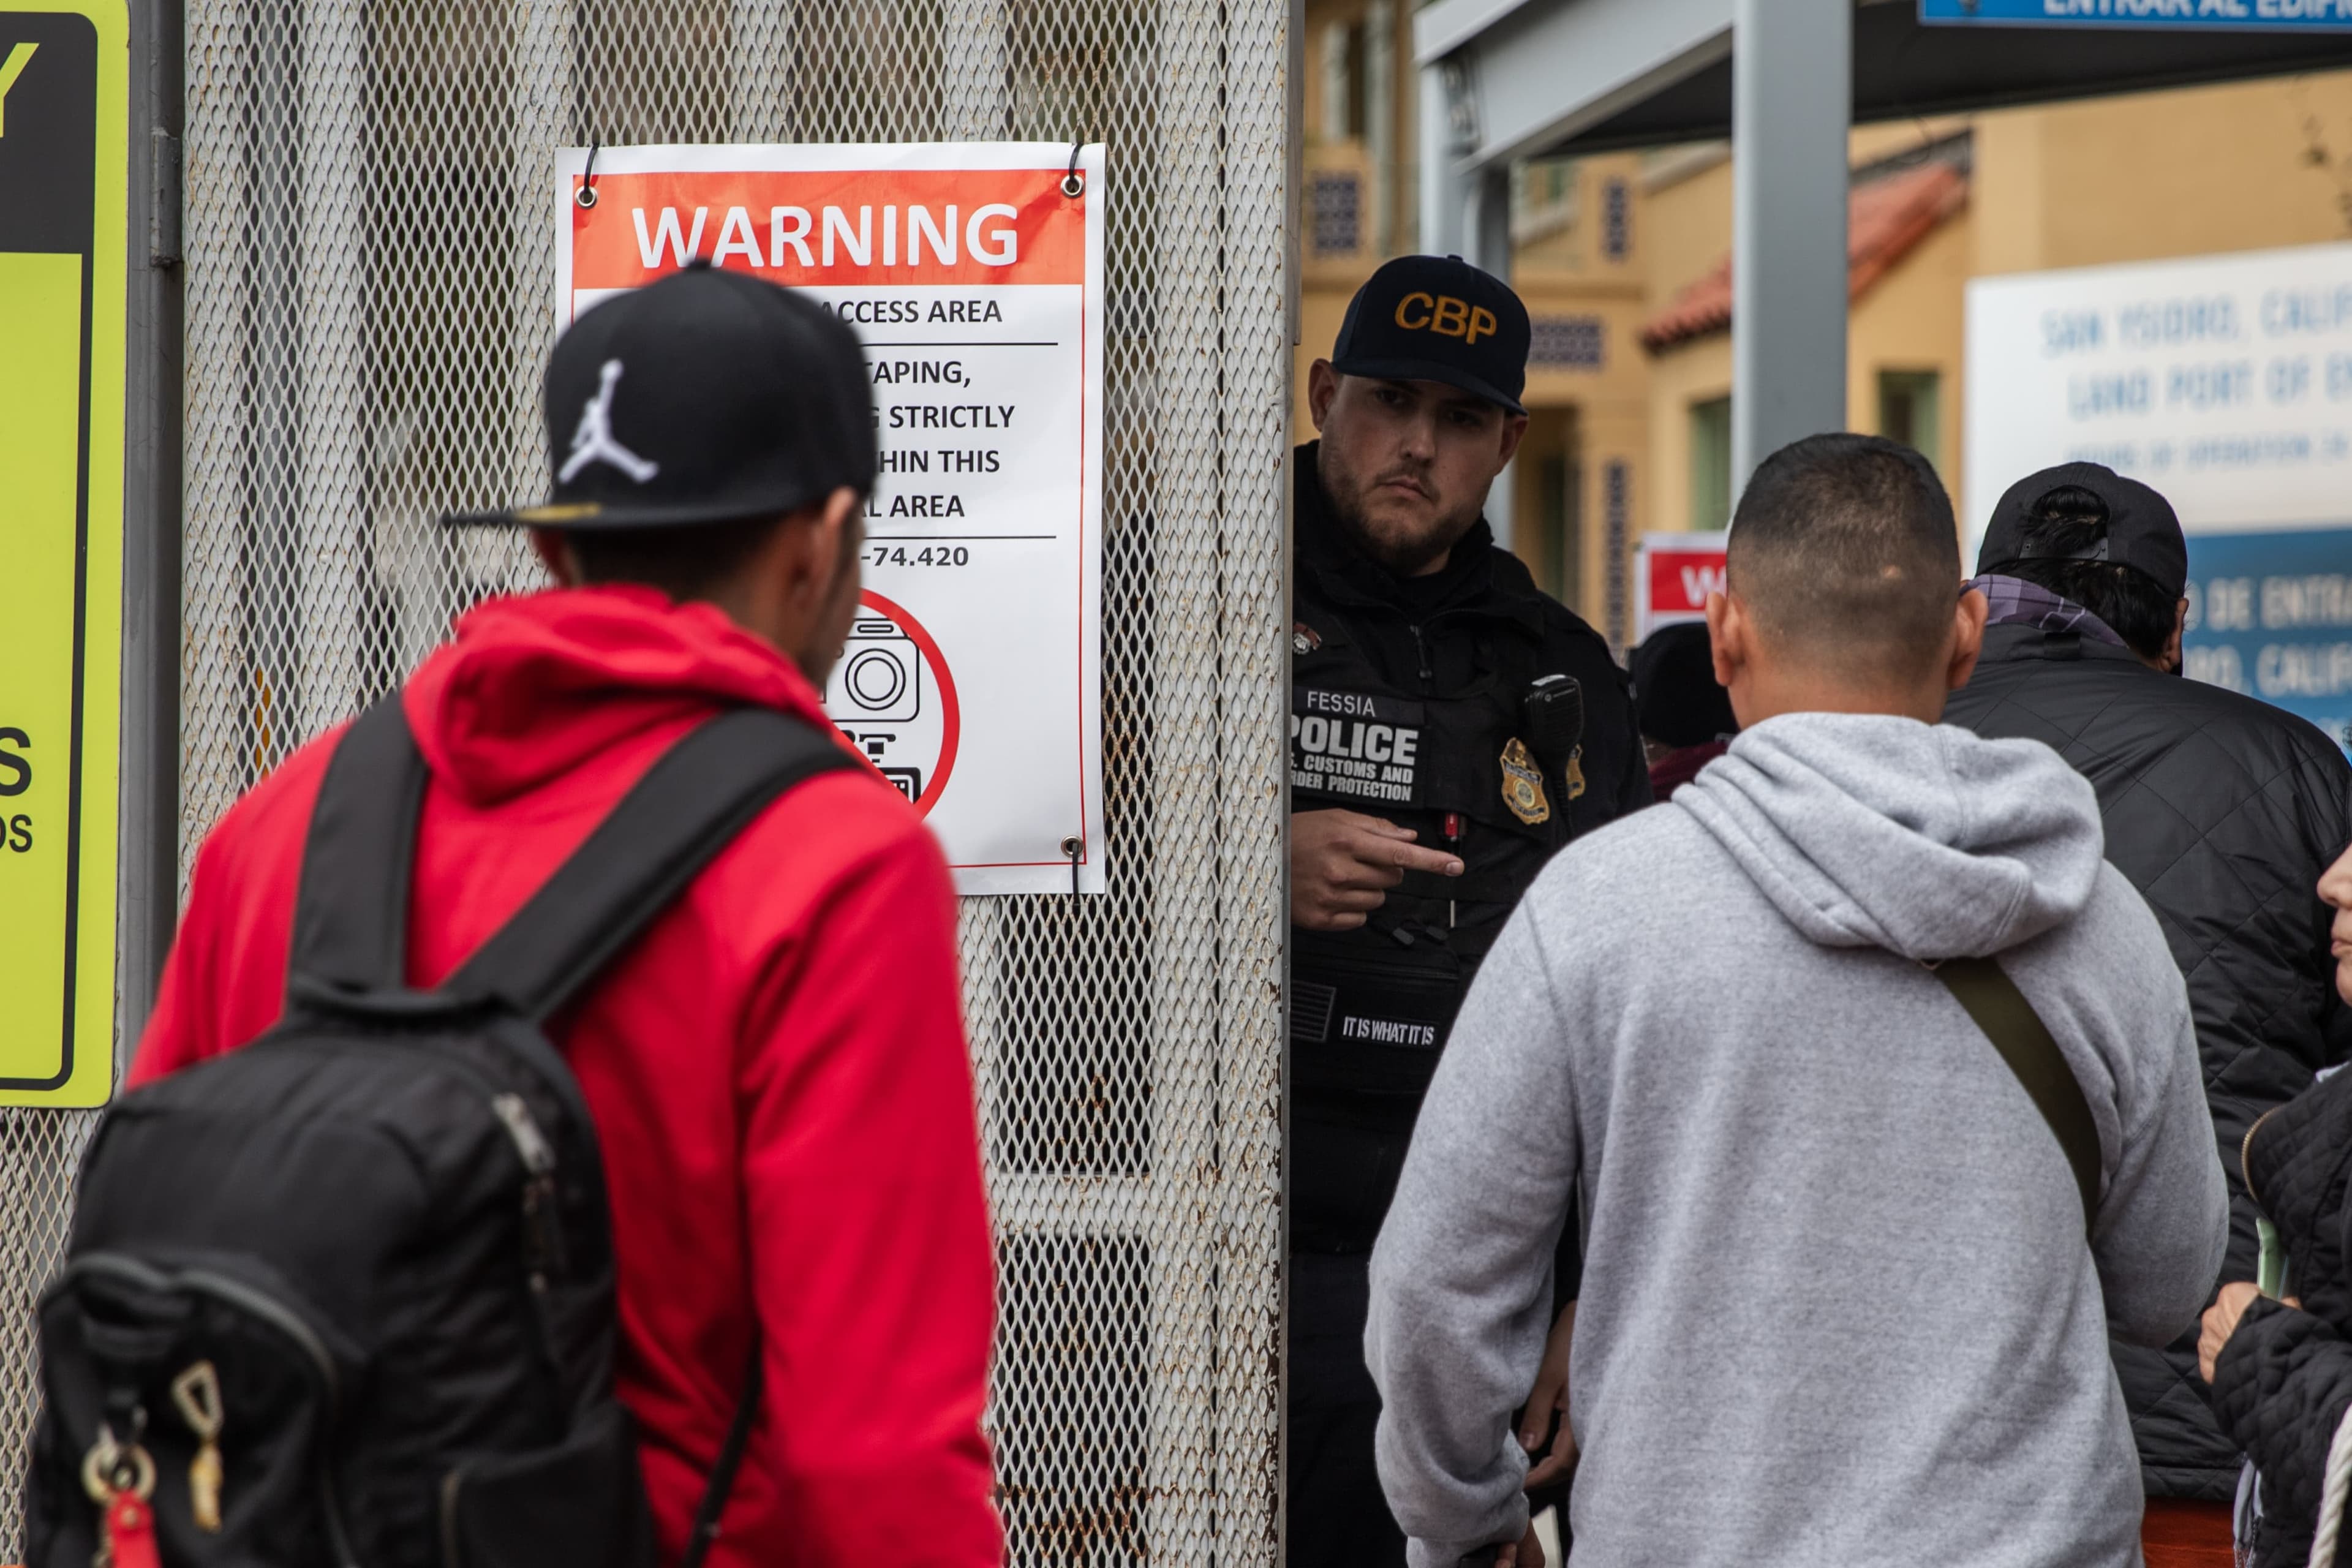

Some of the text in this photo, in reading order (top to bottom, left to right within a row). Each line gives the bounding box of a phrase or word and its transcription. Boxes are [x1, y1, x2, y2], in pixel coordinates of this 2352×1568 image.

[631, 203, 1018, 268] WARNING
[927, 300, 1003, 323] AREA
[1395, 291, 1497, 345] CBP
[889, 405, 1016, 429] STRICTLY
[878, 450, 1000, 473] HIN THIS
[889, 495, 965, 518] AREA
[861, 546, 969, 567] -74.420
[1307, 690, 1376, 717] FESSIA
[1303, 754, 1377, 780] CUSTOMS
[1381, 765, 1414, 784] AND
[1327, 775, 1412, 802] PROTECTION
[1343, 1016, 1434, 1046] IT IS WHAT IT IS
